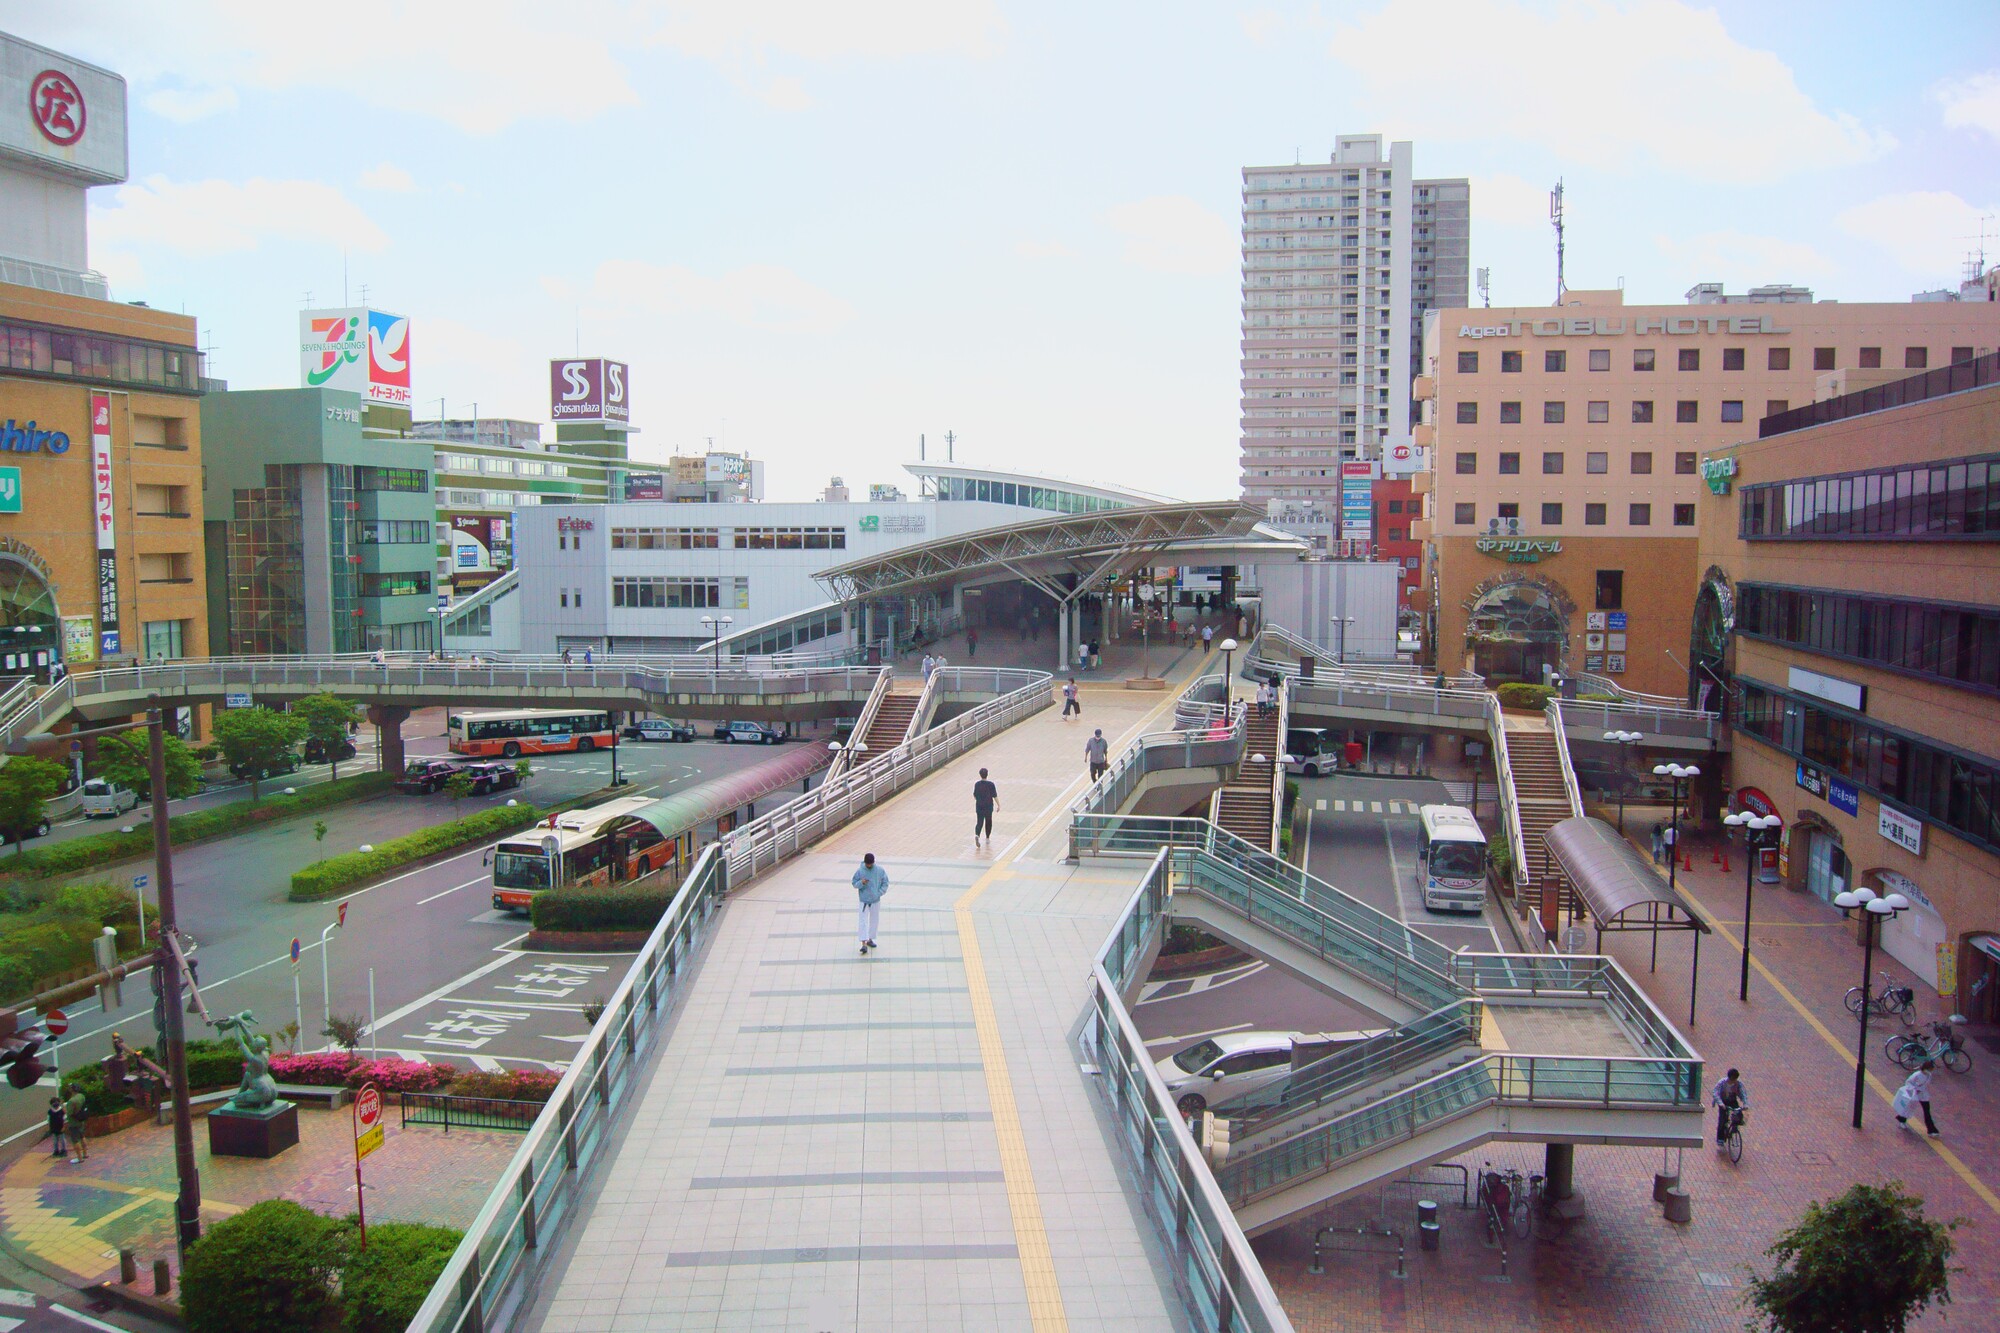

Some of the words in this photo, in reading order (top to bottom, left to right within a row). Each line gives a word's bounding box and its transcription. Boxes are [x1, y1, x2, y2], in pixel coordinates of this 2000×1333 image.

[1502, 316, 1627, 337] TOBU
[1635, 315, 1792, 335] HOTEL
[302, 343, 323, 352] SEVEN
[331, 340, 366, 350] HOLDINGS
[326, 406, 360, 423] プラザ館
[580, 402, 600, 415] plaza
[724, 457, 745, 473] カラオケ
[859, 515, 879, 527] JR
[1496, 540, 1563, 553] アリコベール
[100, 558, 109, 585] ミシン
[103, 638, 117, 651] 4F
[1745, 793, 1768, 815] LOTTERIA
[360, 1097, 378, 1118] 消火栓
